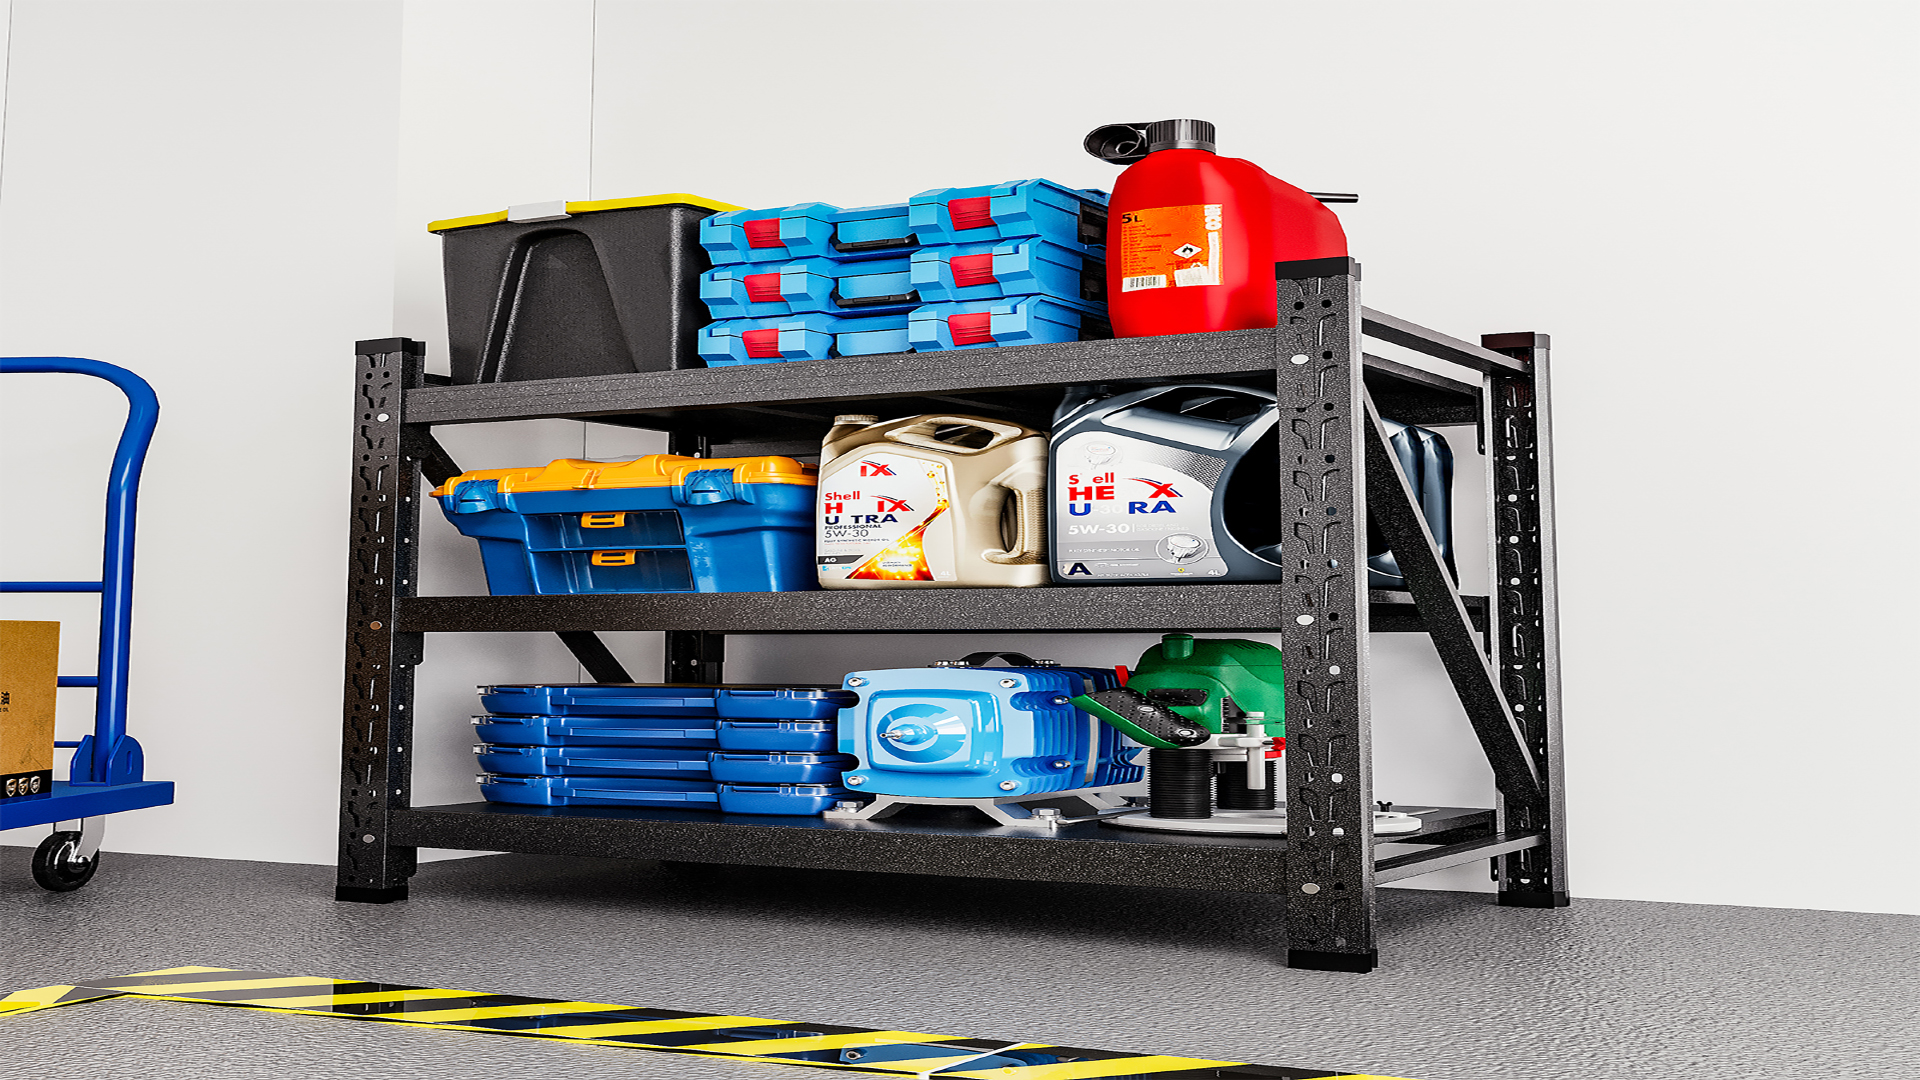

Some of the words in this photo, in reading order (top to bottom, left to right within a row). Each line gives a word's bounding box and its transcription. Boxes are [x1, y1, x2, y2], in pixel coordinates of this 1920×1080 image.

[1121, 213, 1133, 224] 5
[825, 490, 861, 501] Shell
[824, 529, 869, 539] 5W-30
[1068, 523, 1131, 535] 5W-30
